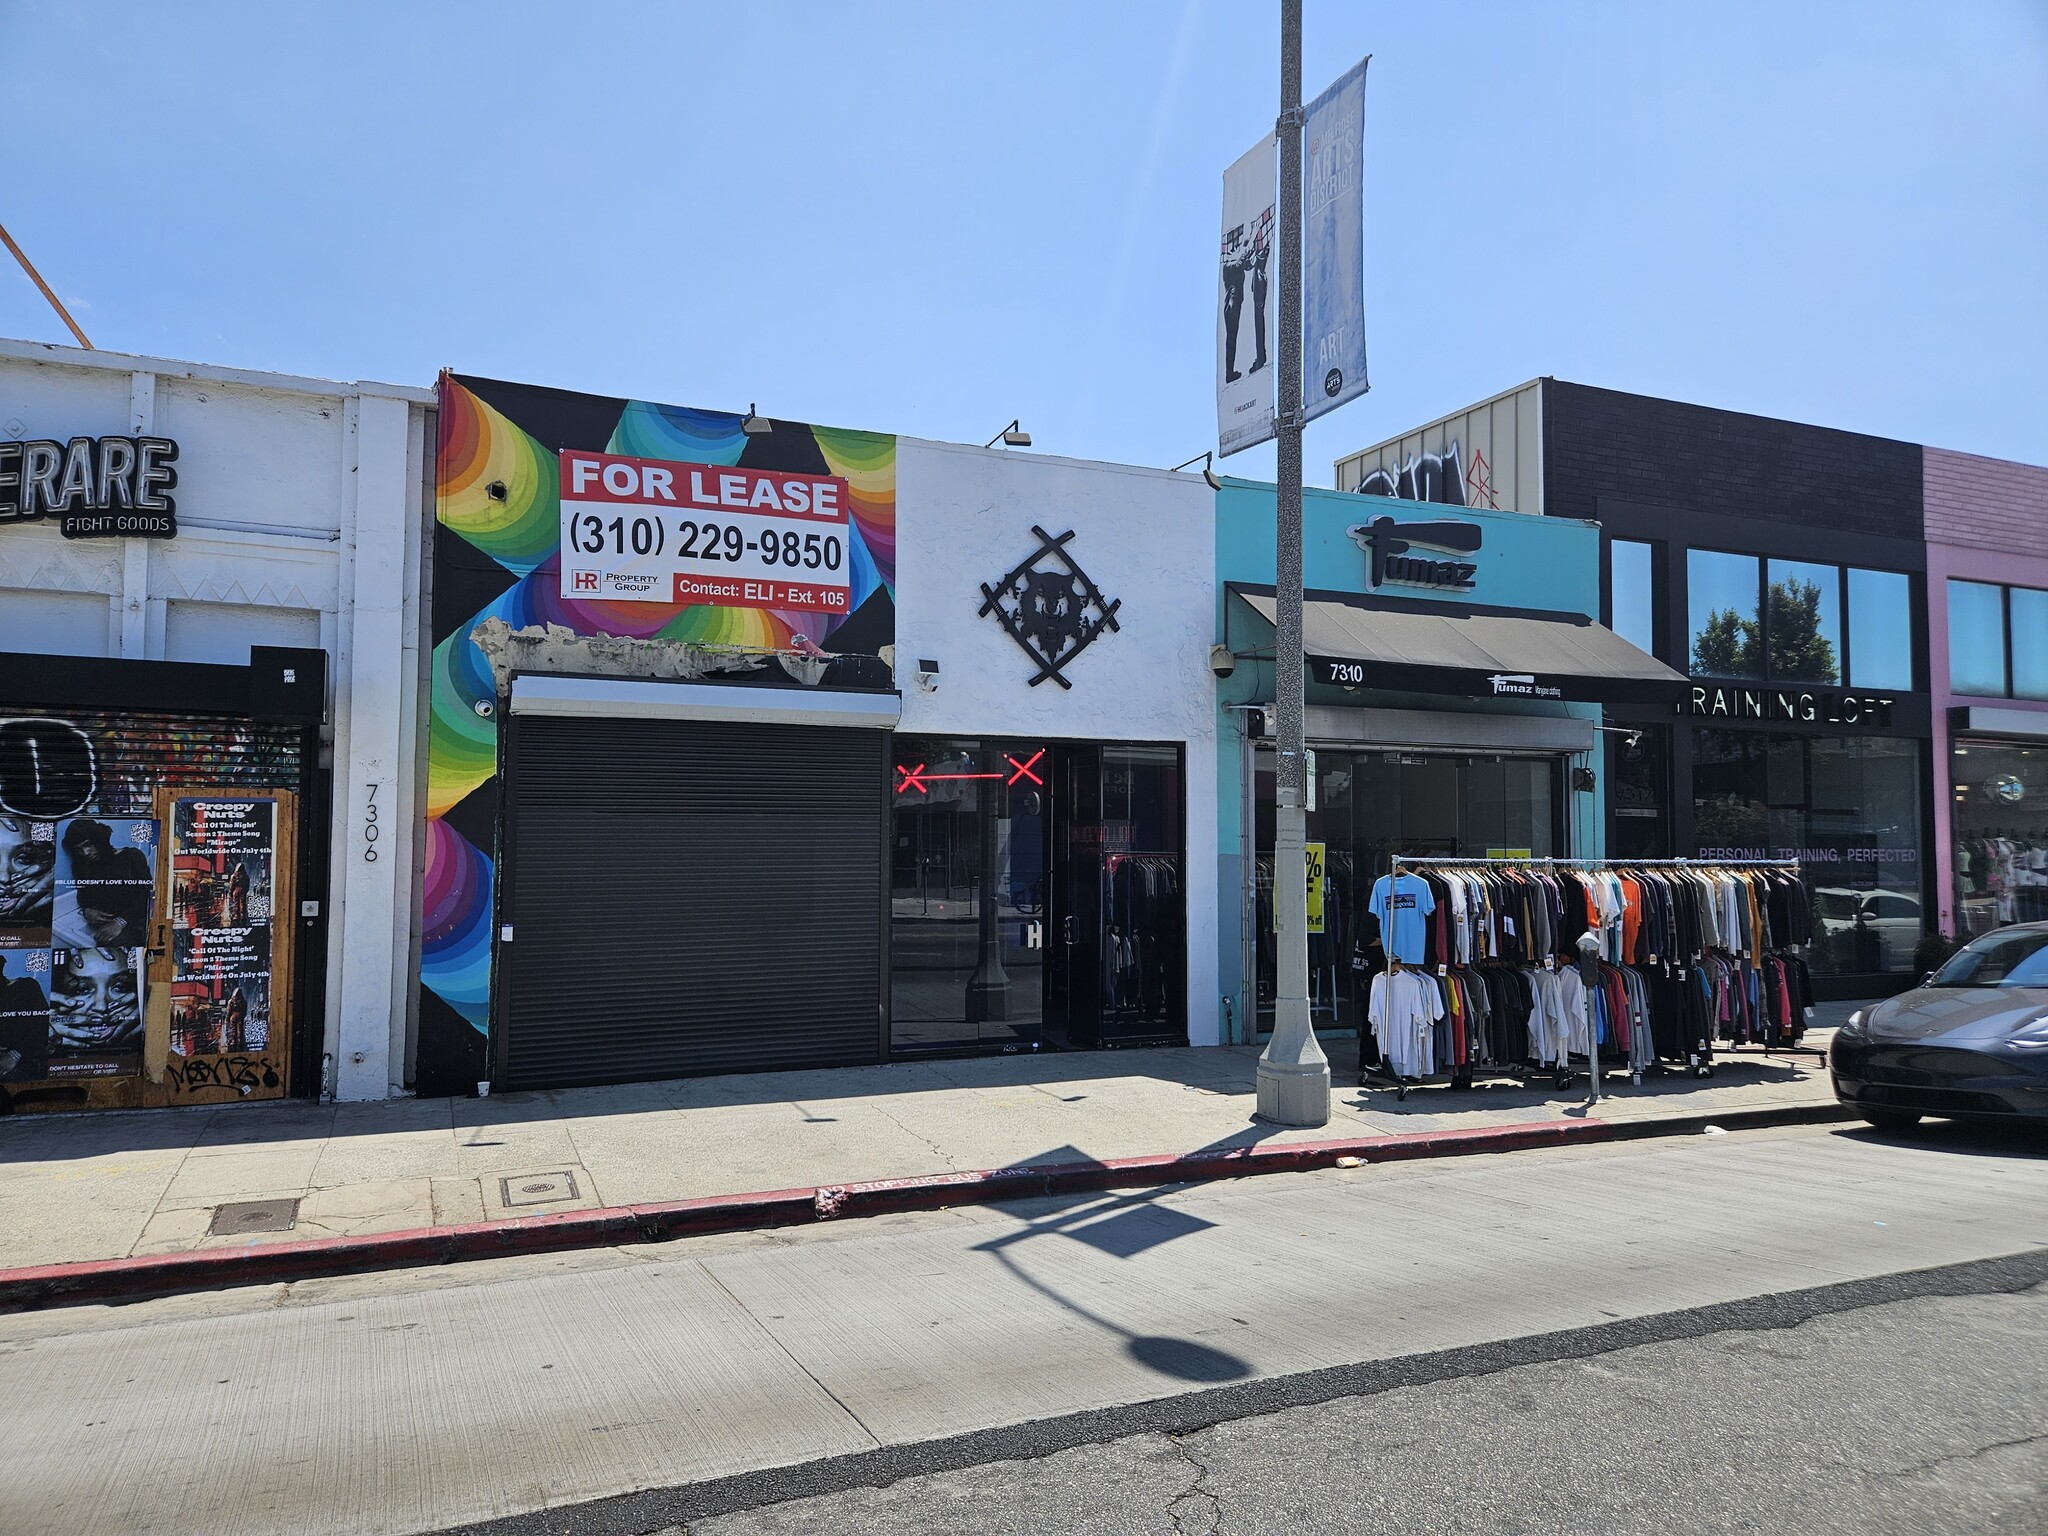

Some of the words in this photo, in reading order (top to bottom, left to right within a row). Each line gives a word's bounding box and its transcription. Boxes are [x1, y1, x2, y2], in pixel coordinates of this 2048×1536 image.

[1311, 128, 1354, 191] ARTS
[1311, 163, 1354, 211] DISTRICT
[1319, 326, 1345, 365] ART
[572, 458, 676, 501] FOR
[690, 471, 839, 517] LEASE
[66, 516, 114, 532] FIGHT
[117, 516, 170, 531] GOODS
[570, 512, 665, 556] (310)
[678, 520, 842, 571] 229-9850
[575, 572, 598, 590] HR
[679, 579, 739, 598] Contact:
[744, 582, 774, 601] ELI
[787, 588, 816, 605] Ext.
[819, 591, 845, 606] 105
[1329, 663, 1363, 683] 7310
[193, 802, 255, 811] Creepy
[204, 811, 246, 819] Nuts
[365, 784, 379, 862] 7306
[1778, 848, 1841, 864] TRAINING,
[1847, 849, 1916, 862] PERFECTED
[191, 928, 253, 936] Creepy
[201, 936, 243, 944] Nuts
[853, 1176, 939, 1192] STOPPING
[947, 1172, 983, 1183] BUS
[989, 1167, 1034, 1178] ZONE
